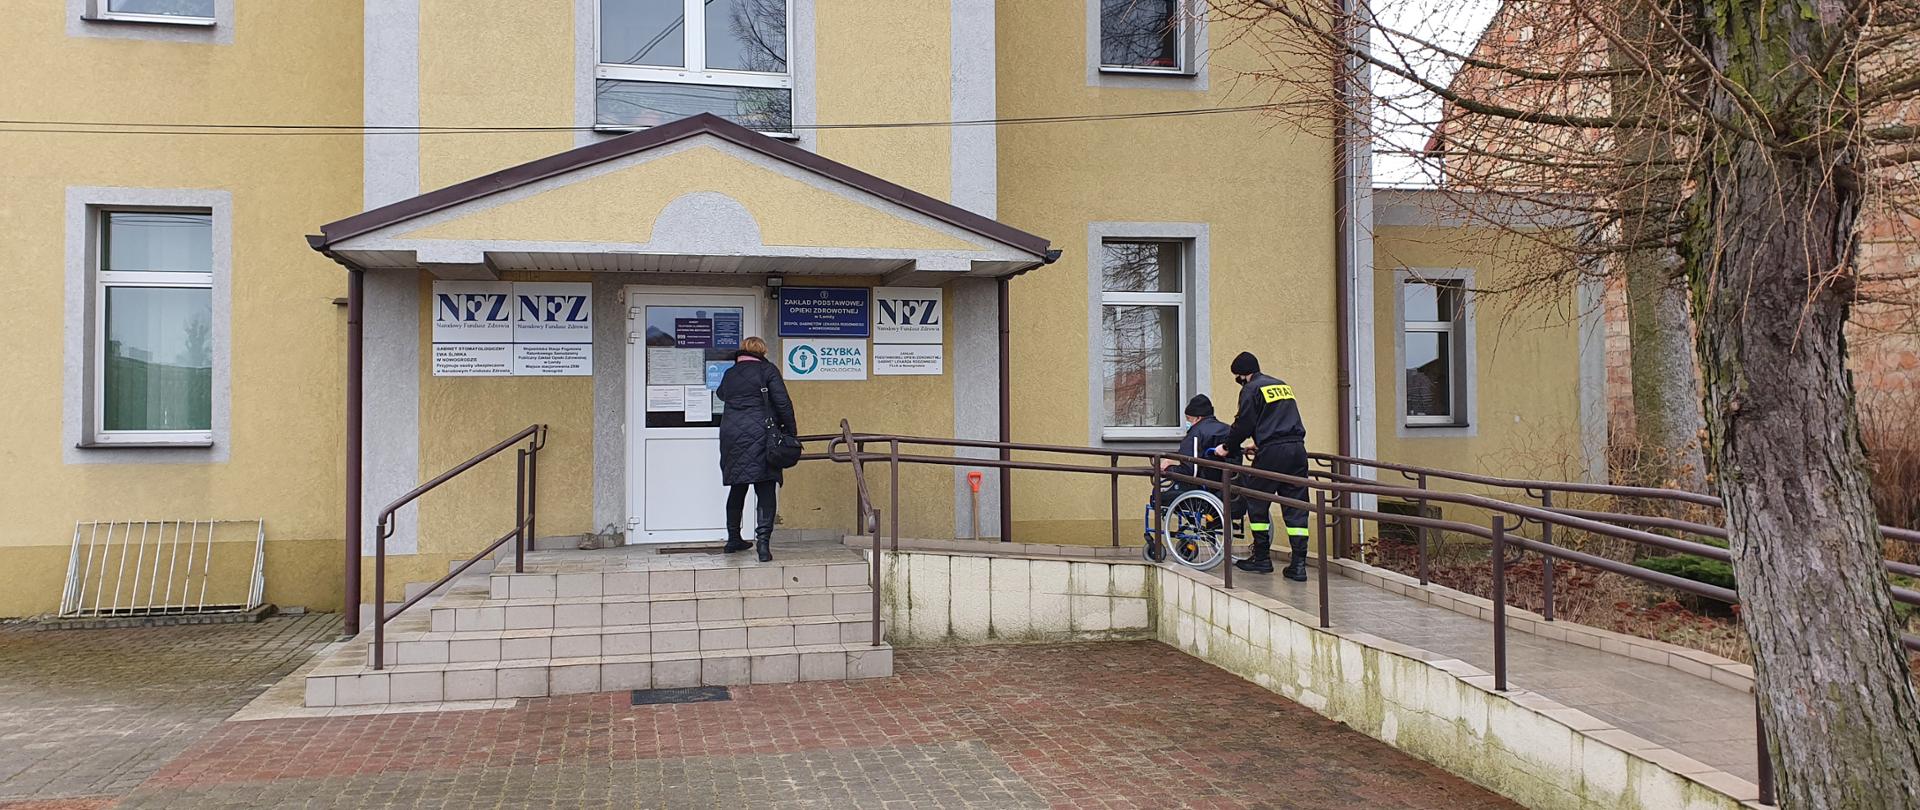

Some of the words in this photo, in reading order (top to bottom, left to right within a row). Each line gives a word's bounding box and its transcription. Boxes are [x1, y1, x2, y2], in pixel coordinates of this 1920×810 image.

[436, 294, 510, 322] NFZ
[517, 295, 588, 322] NFZ
[876, 298, 939, 325] NFZ
[436, 322, 462, 330] Narodowy
[820, 347, 861, 356] SZYBKA
[820, 357, 862, 366] TERAPIA
